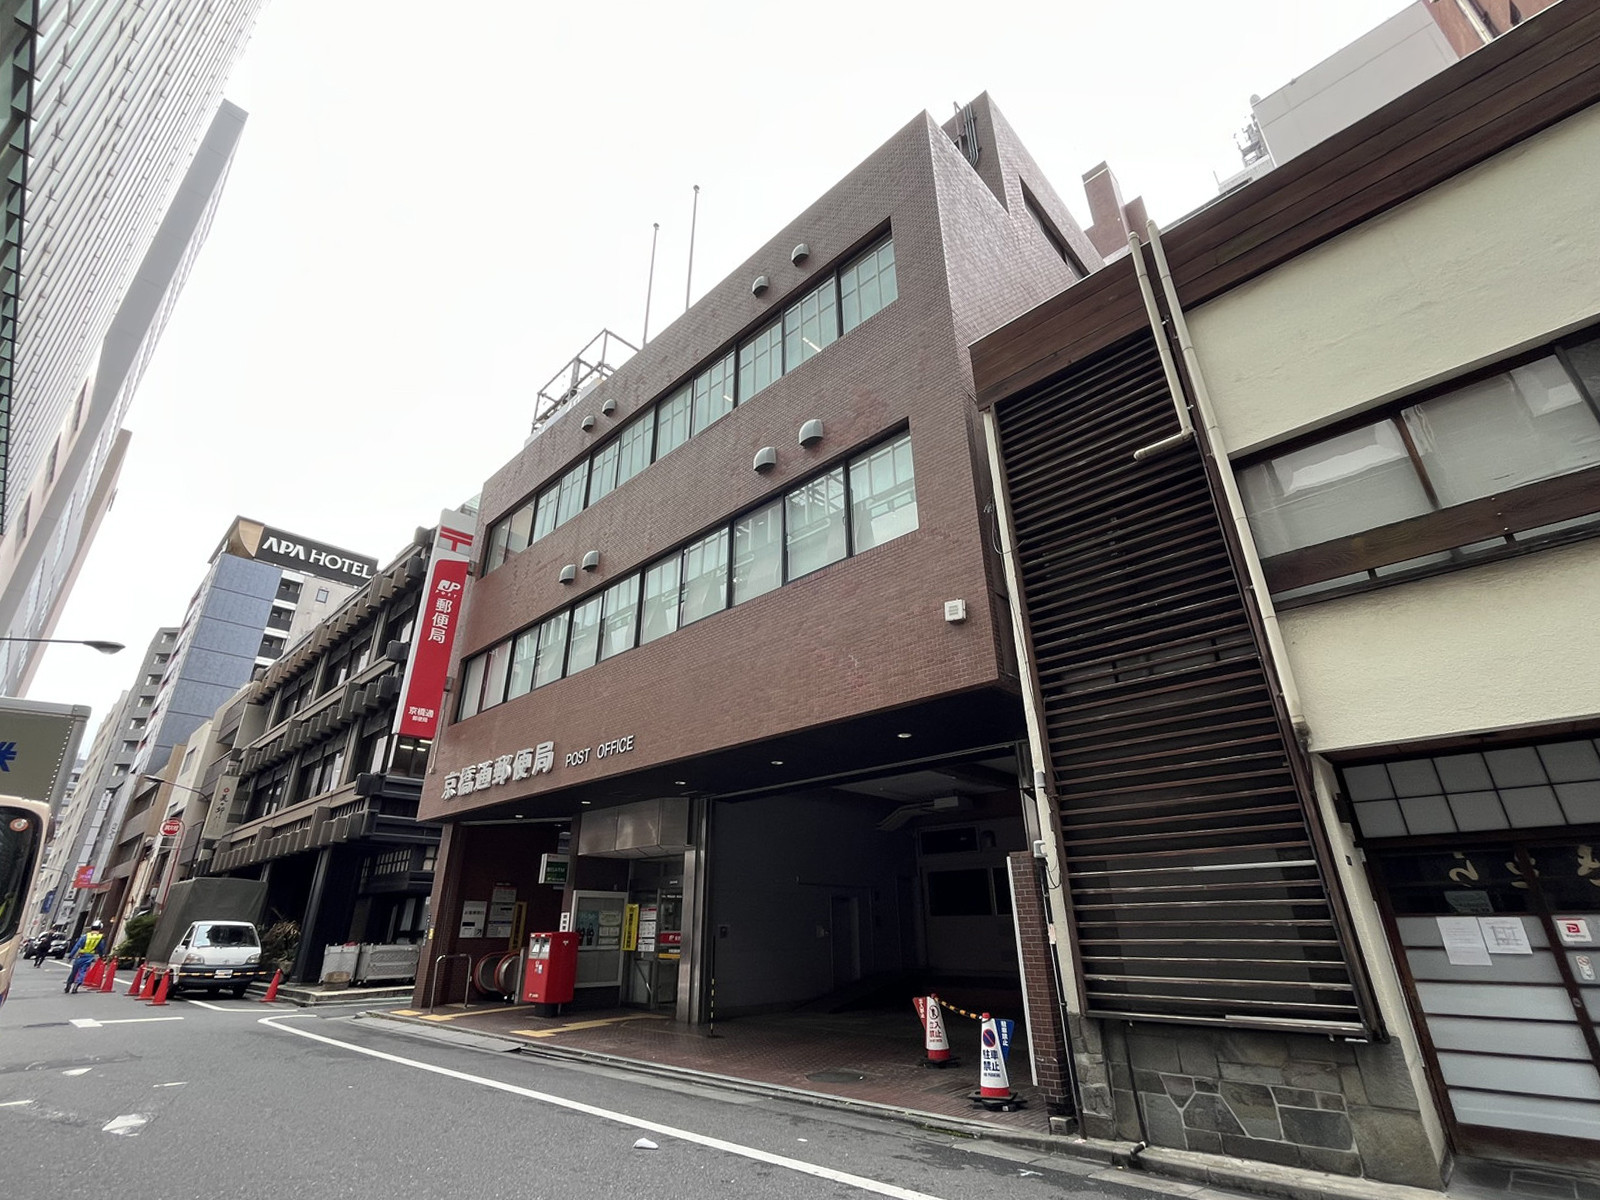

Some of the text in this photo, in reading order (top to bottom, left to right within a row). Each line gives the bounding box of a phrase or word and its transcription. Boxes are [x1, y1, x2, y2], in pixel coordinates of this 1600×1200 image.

[262, 536, 372, 579] APA HOTEL
[428, 598, 453, 644] 郵便局
[441, 741, 555, 800] 京橋通郵便局
[565, 735, 635, 768] POST OFFICE
[983, 1060, 1001, 1072] 禁止
